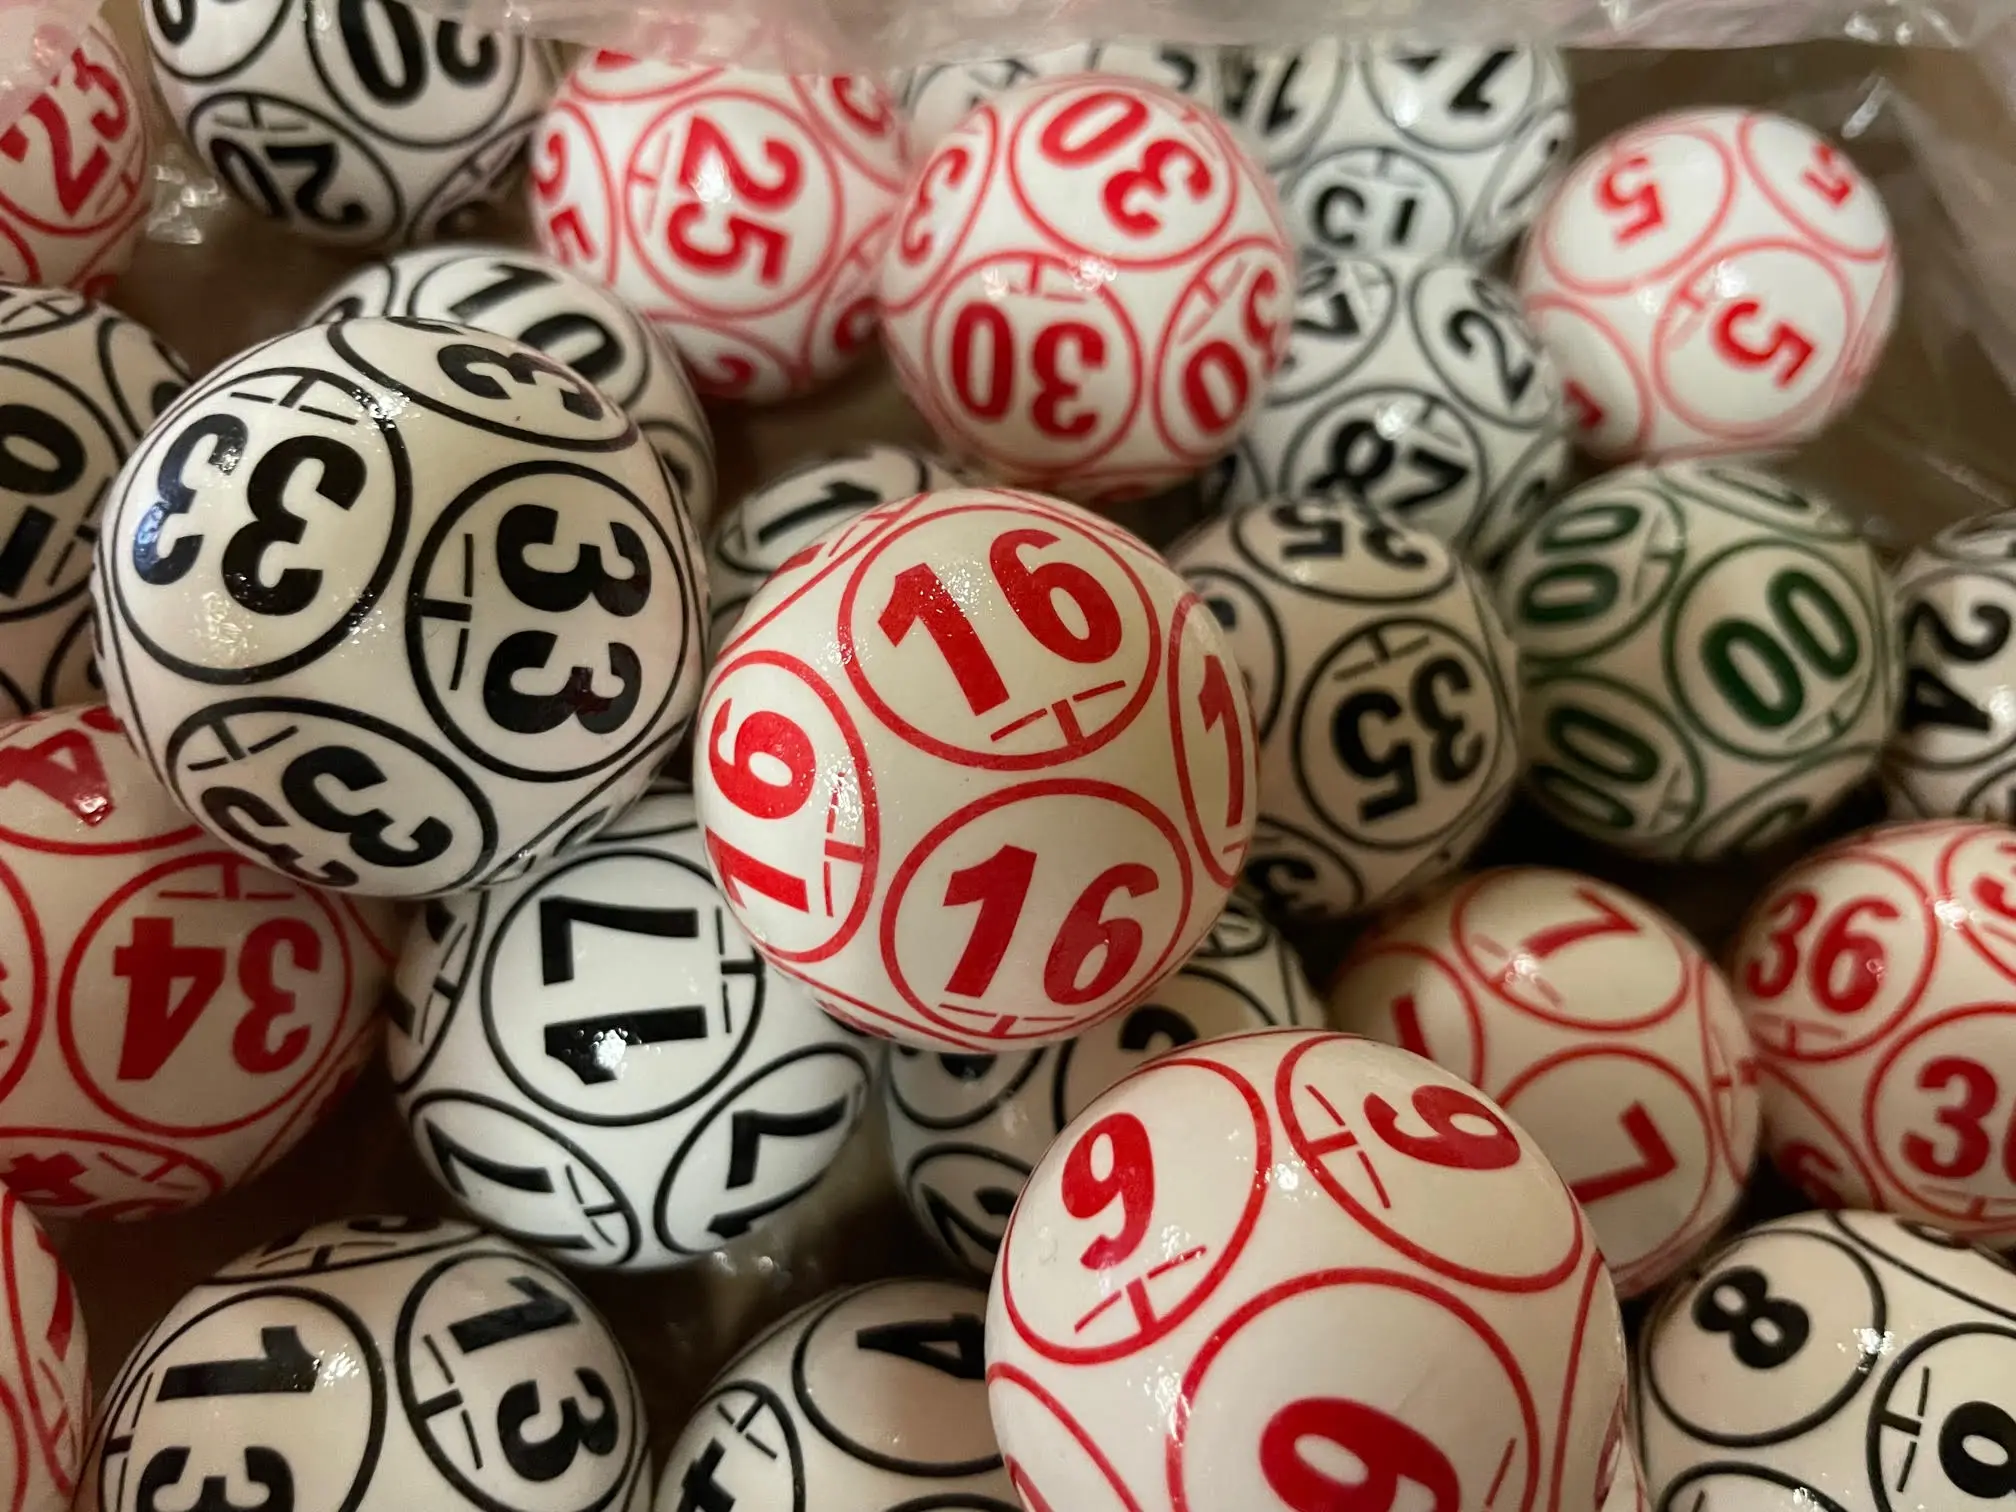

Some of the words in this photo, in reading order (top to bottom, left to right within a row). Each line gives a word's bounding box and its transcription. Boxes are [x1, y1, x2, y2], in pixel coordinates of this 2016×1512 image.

[209, 137, 372, 227] 20
[667, 115, 803, 286] 25
[899, 147, 971, 266] 3
[1040, 92, 1213, 238] 30
[1596, 154, 1665, 248] 5
[1802, 143, 1854, 209] 5
[951, 302, 1108, 437] 30
[1710, 300, 1818, 389] 5
[132, 413, 368, 617] 33
[757, 481, 886, 545] 1
[1518, 503, 1643, 626] 00
[483, 503, 652, 735] 33
[877, 528, 1124, 717] 16
[1702, 570, 1861, 730] 00
[1902, 601, 2013, 736] 24
[703, 697, 817, 914] 16
[1197, 654, 1245, 828] 1
[1333, 655, 1487, 824] 35
[1530, 706, 1660, 829] 00
[200, 745, 453, 888] 33
[539, 896, 709, 1086] 17
[942, 843, 1161, 1006] 16
[1516, 887, 1646, 970] 7
[1745, 891, 1900, 1016] 36
[114, 915, 323, 1082] 34
[1362, 1084, 1523, 1172] 9
[1566, 1101, 1679, 1206] 7
[1902, 1054, 2016, 1182] 3
[1061, 1112, 1156, 1271] 9
[446, 1276, 620, 1482] 13
[856, 1312, 989, 1382] 4
[1691, 1264, 1811, 1371] 8
[136, 1325, 323, 1512] 13
